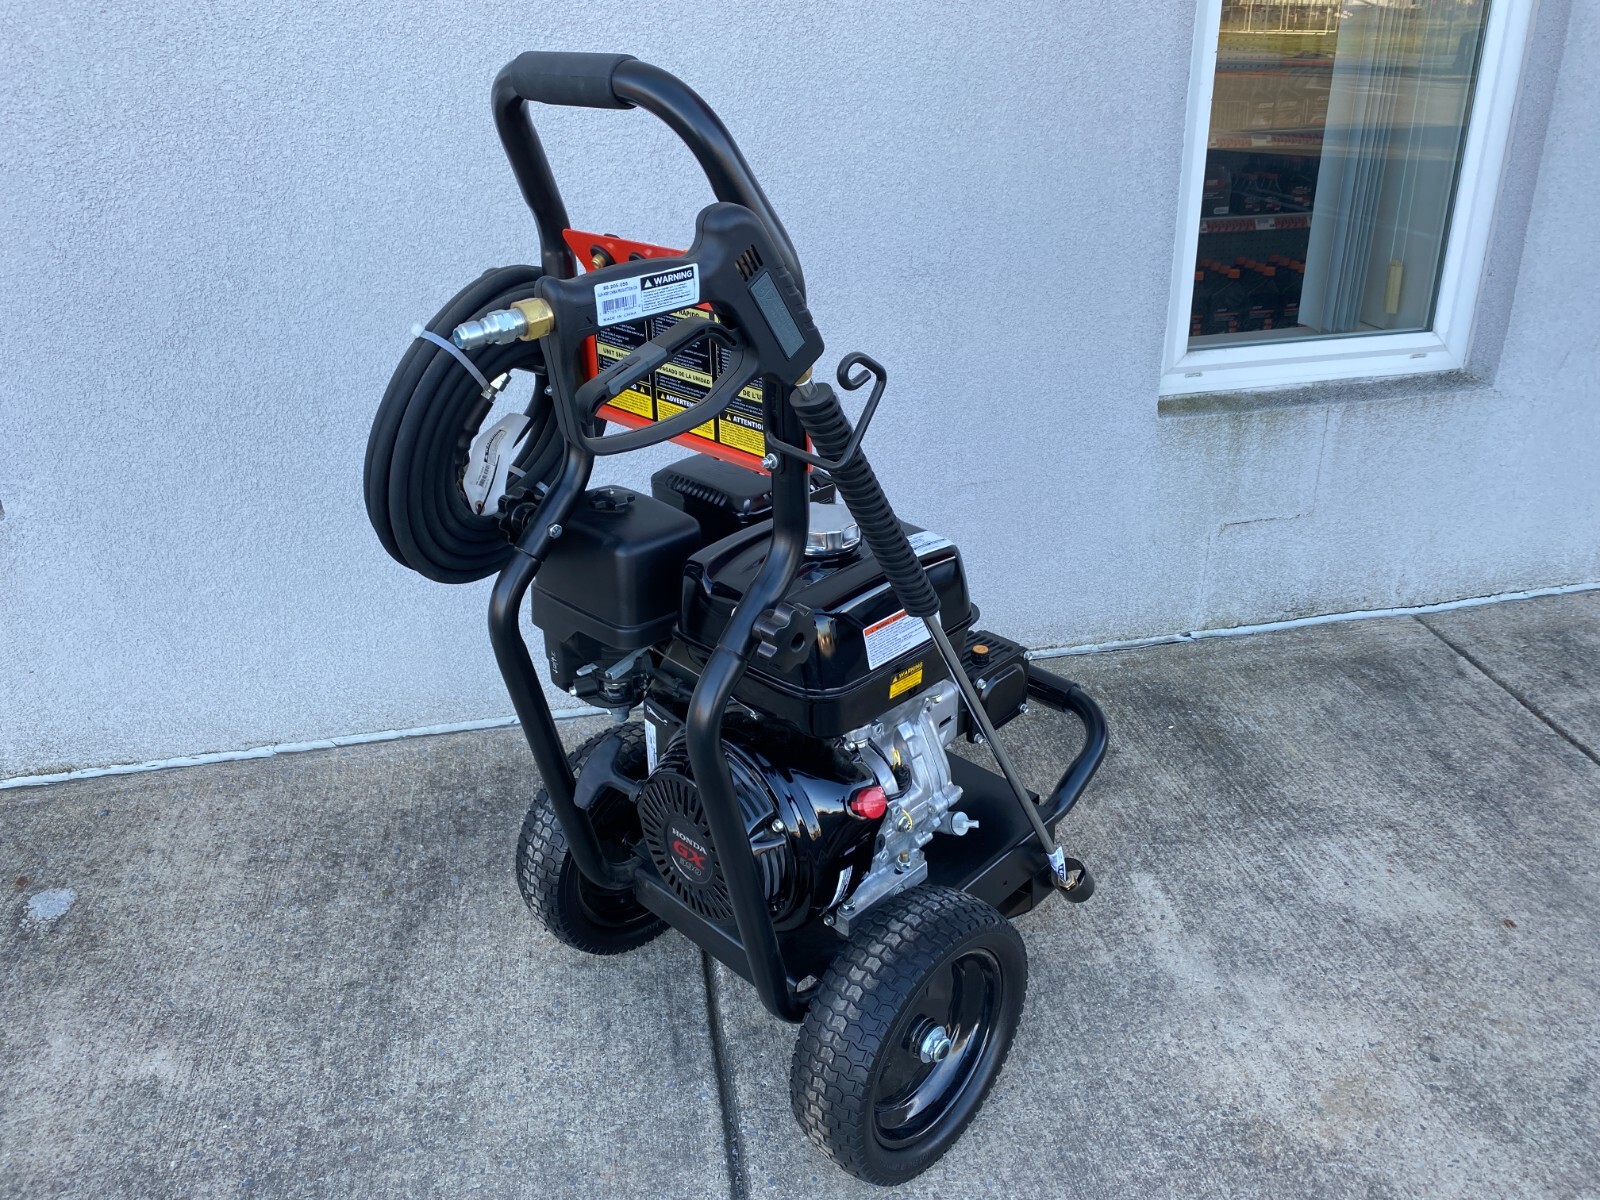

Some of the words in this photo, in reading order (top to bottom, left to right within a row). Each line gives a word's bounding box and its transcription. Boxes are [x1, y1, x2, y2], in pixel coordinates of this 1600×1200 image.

[653, 269, 693, 286] WARNING
[602, 347, 615, 356] UNIT
[692, 375, 711, 385] UNIDAD
[742, 389, 751, 398] DE
[665, 394, 697, 408] ADVERTEN
[672, 827, 708, 856] HONDA
[673, 840, 705, 871] GX
